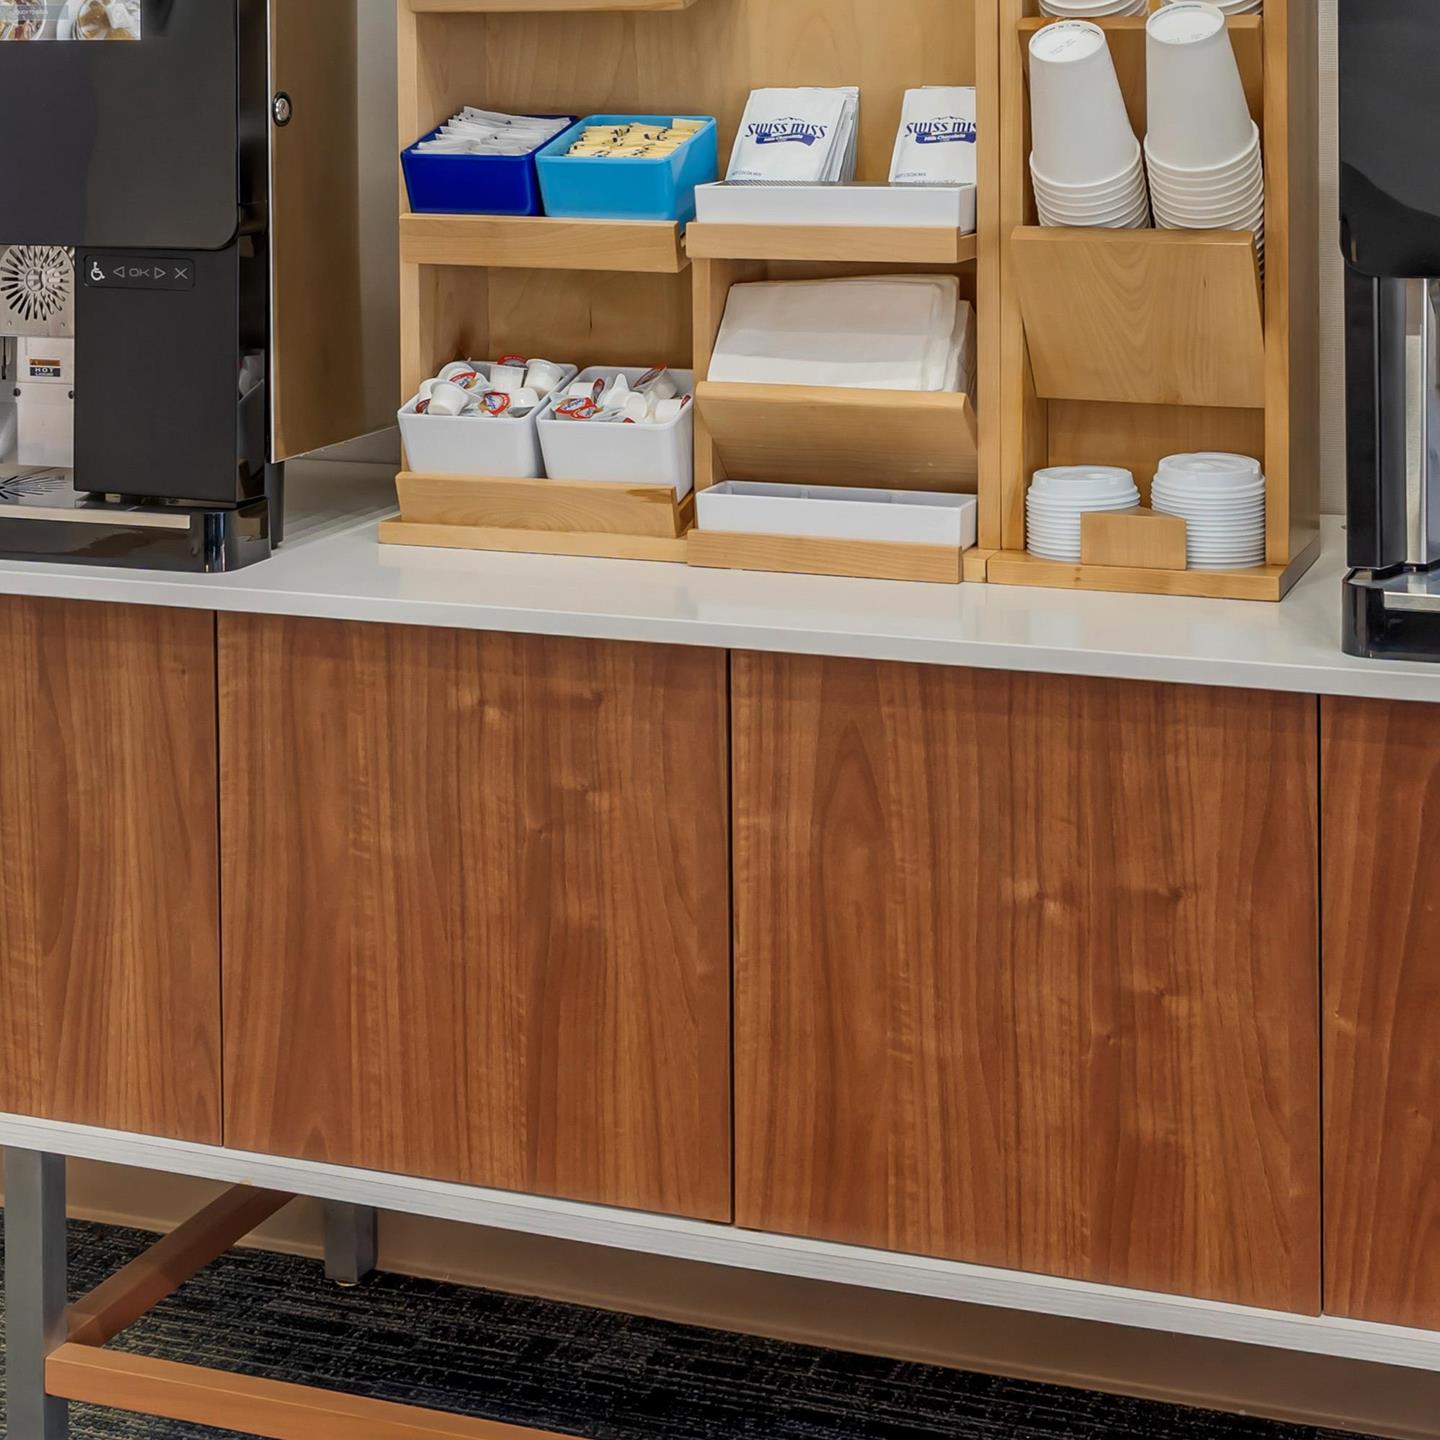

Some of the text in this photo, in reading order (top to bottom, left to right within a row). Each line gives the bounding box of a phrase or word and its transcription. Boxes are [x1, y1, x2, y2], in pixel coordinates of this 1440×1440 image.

[745, 123, 788, 137] SWISS
[904, 122, 976, 137] SWISS MI
[129, 268, 150, 277] OK
